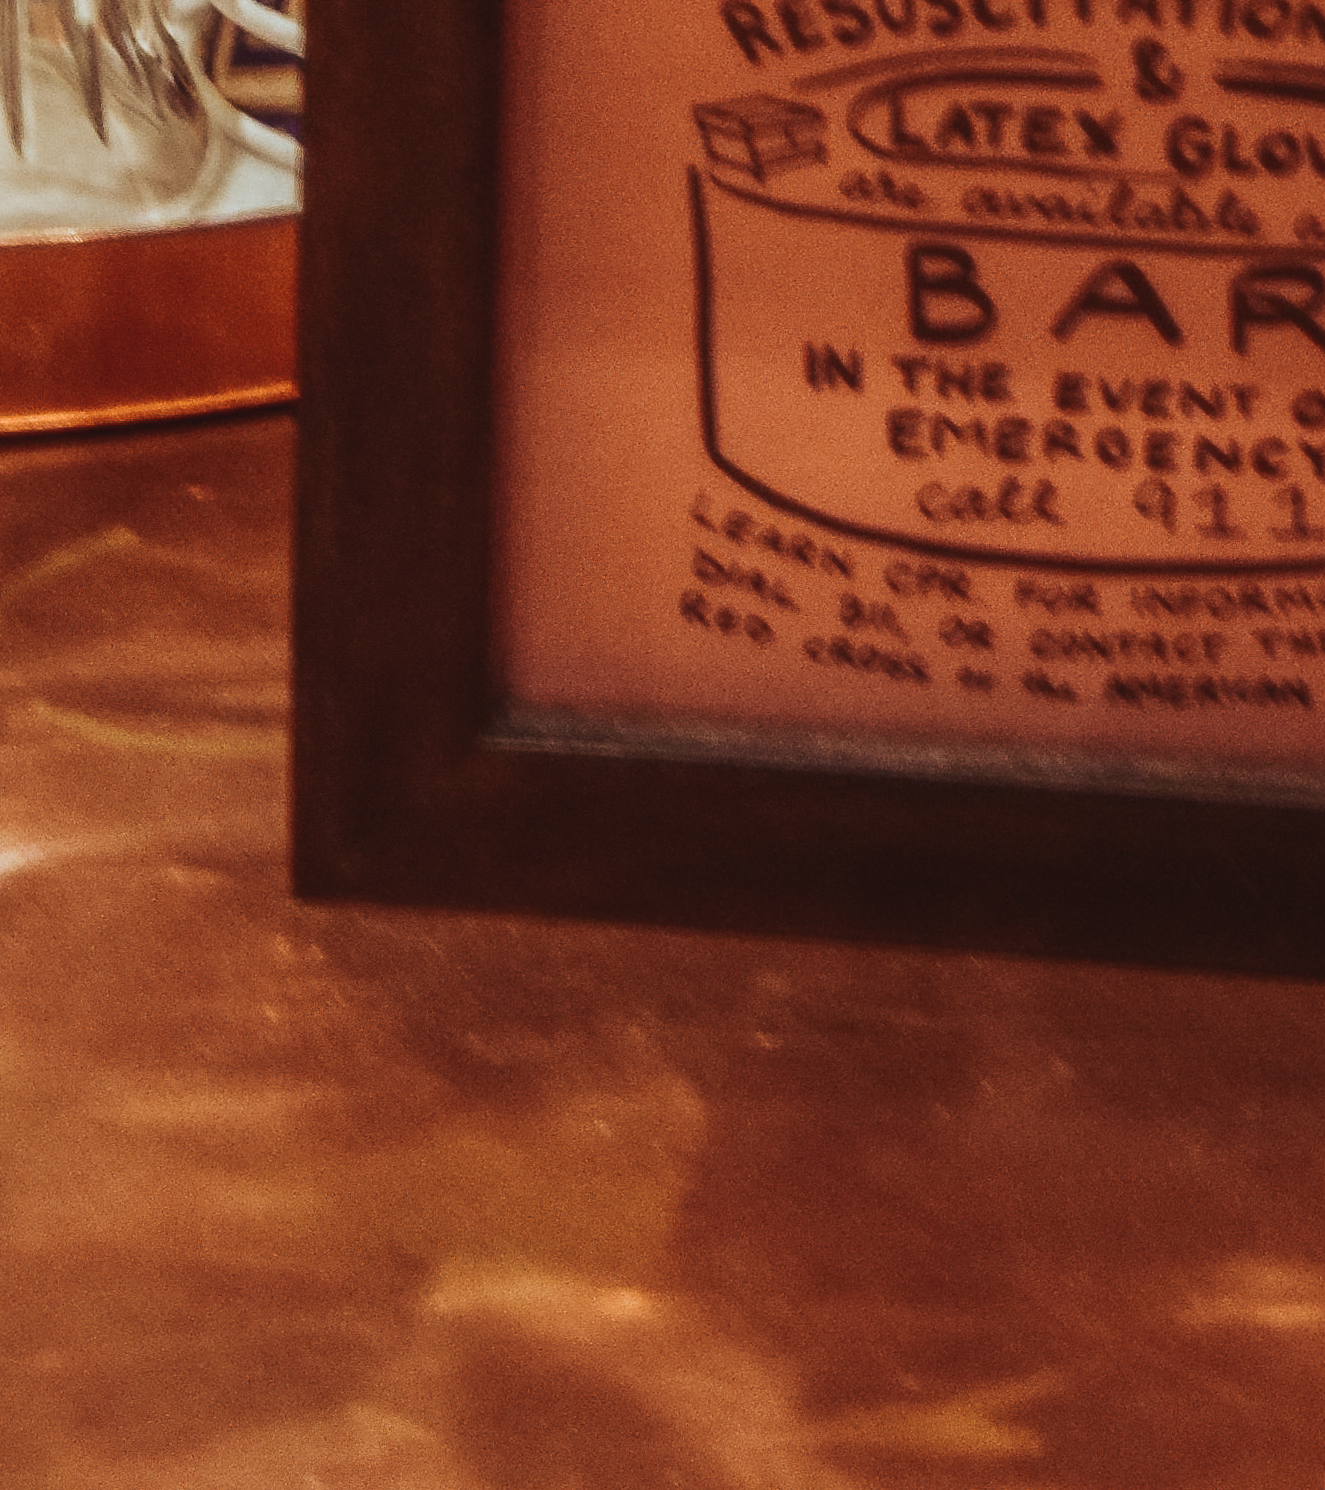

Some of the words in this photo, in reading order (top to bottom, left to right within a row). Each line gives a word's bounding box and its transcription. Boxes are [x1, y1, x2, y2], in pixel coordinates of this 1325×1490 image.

[1128, 34, 1185, 104] &
[885, 91, 1126, 159] LATEX
[802, 339, 866, 394] IN
[890, 351, 1013, 405] THE
[1050, 368, 1260, 423] EVENT
[689, 489, 856, 578] LEARN
[1014, 576, 1104, 618] FOR
